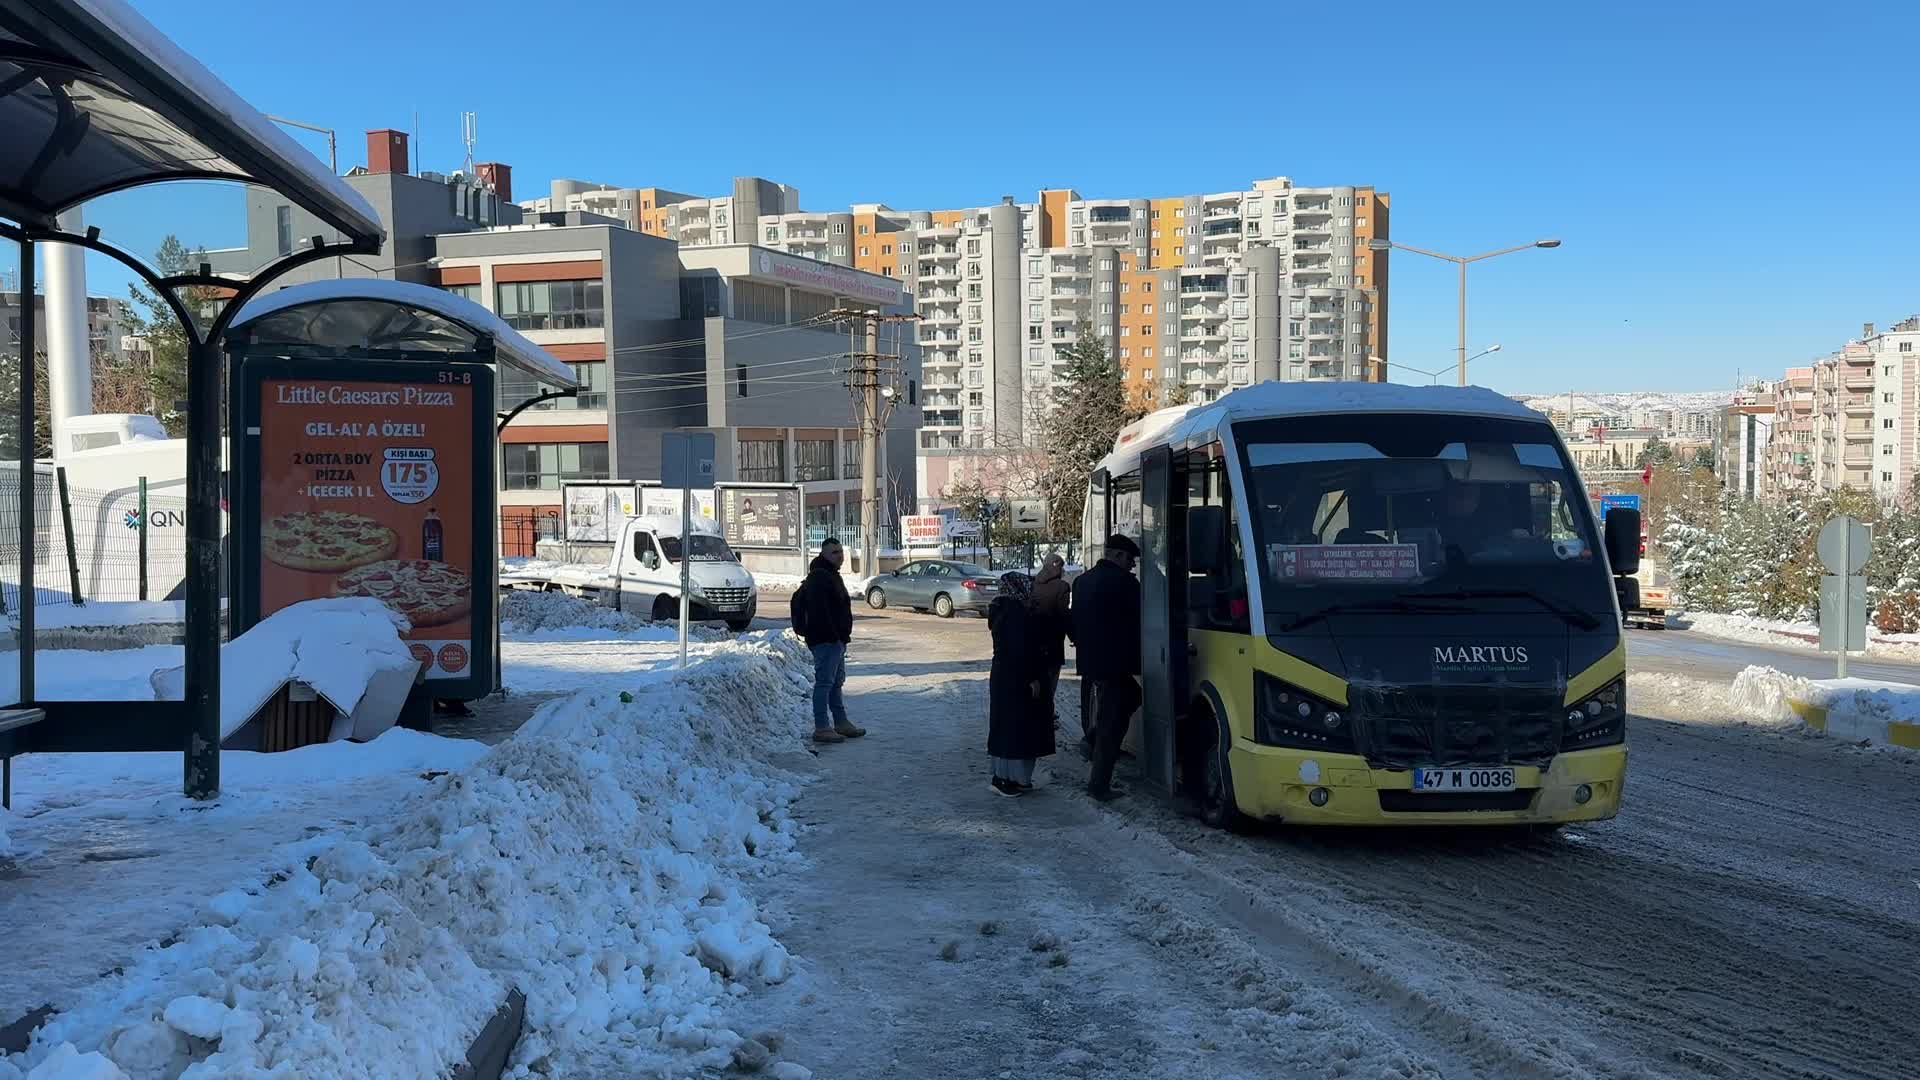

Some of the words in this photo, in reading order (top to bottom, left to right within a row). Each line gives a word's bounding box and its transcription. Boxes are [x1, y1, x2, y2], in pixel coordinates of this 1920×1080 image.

[276, 385, 326, 404] Little
[328, 386, 400, 405] Caesars
[402, 387, 454, 406] Pizza
[366, 423, 378, 437] A
[382, 419, 426, 437] ÖZEL!
[293, 452, 303, 465] 2
[304, 452, 342, 465] ORTA
[345, 452, 373, 465] BOY
[316, 466, 356, 481] PİZZA
[357, 485, 363, 497] 1
[366, 485, 375, 497] L
[909, 527, 940, 537] SOFRASI
[1285, 565, 1296, 577] 6
[1433, 646, 1529, 663] MARTUS
[1423, 771, 1444, 788] 47
[1452, 771, 1462, 788] M
[1469, 770, 1512, 788] 0036
